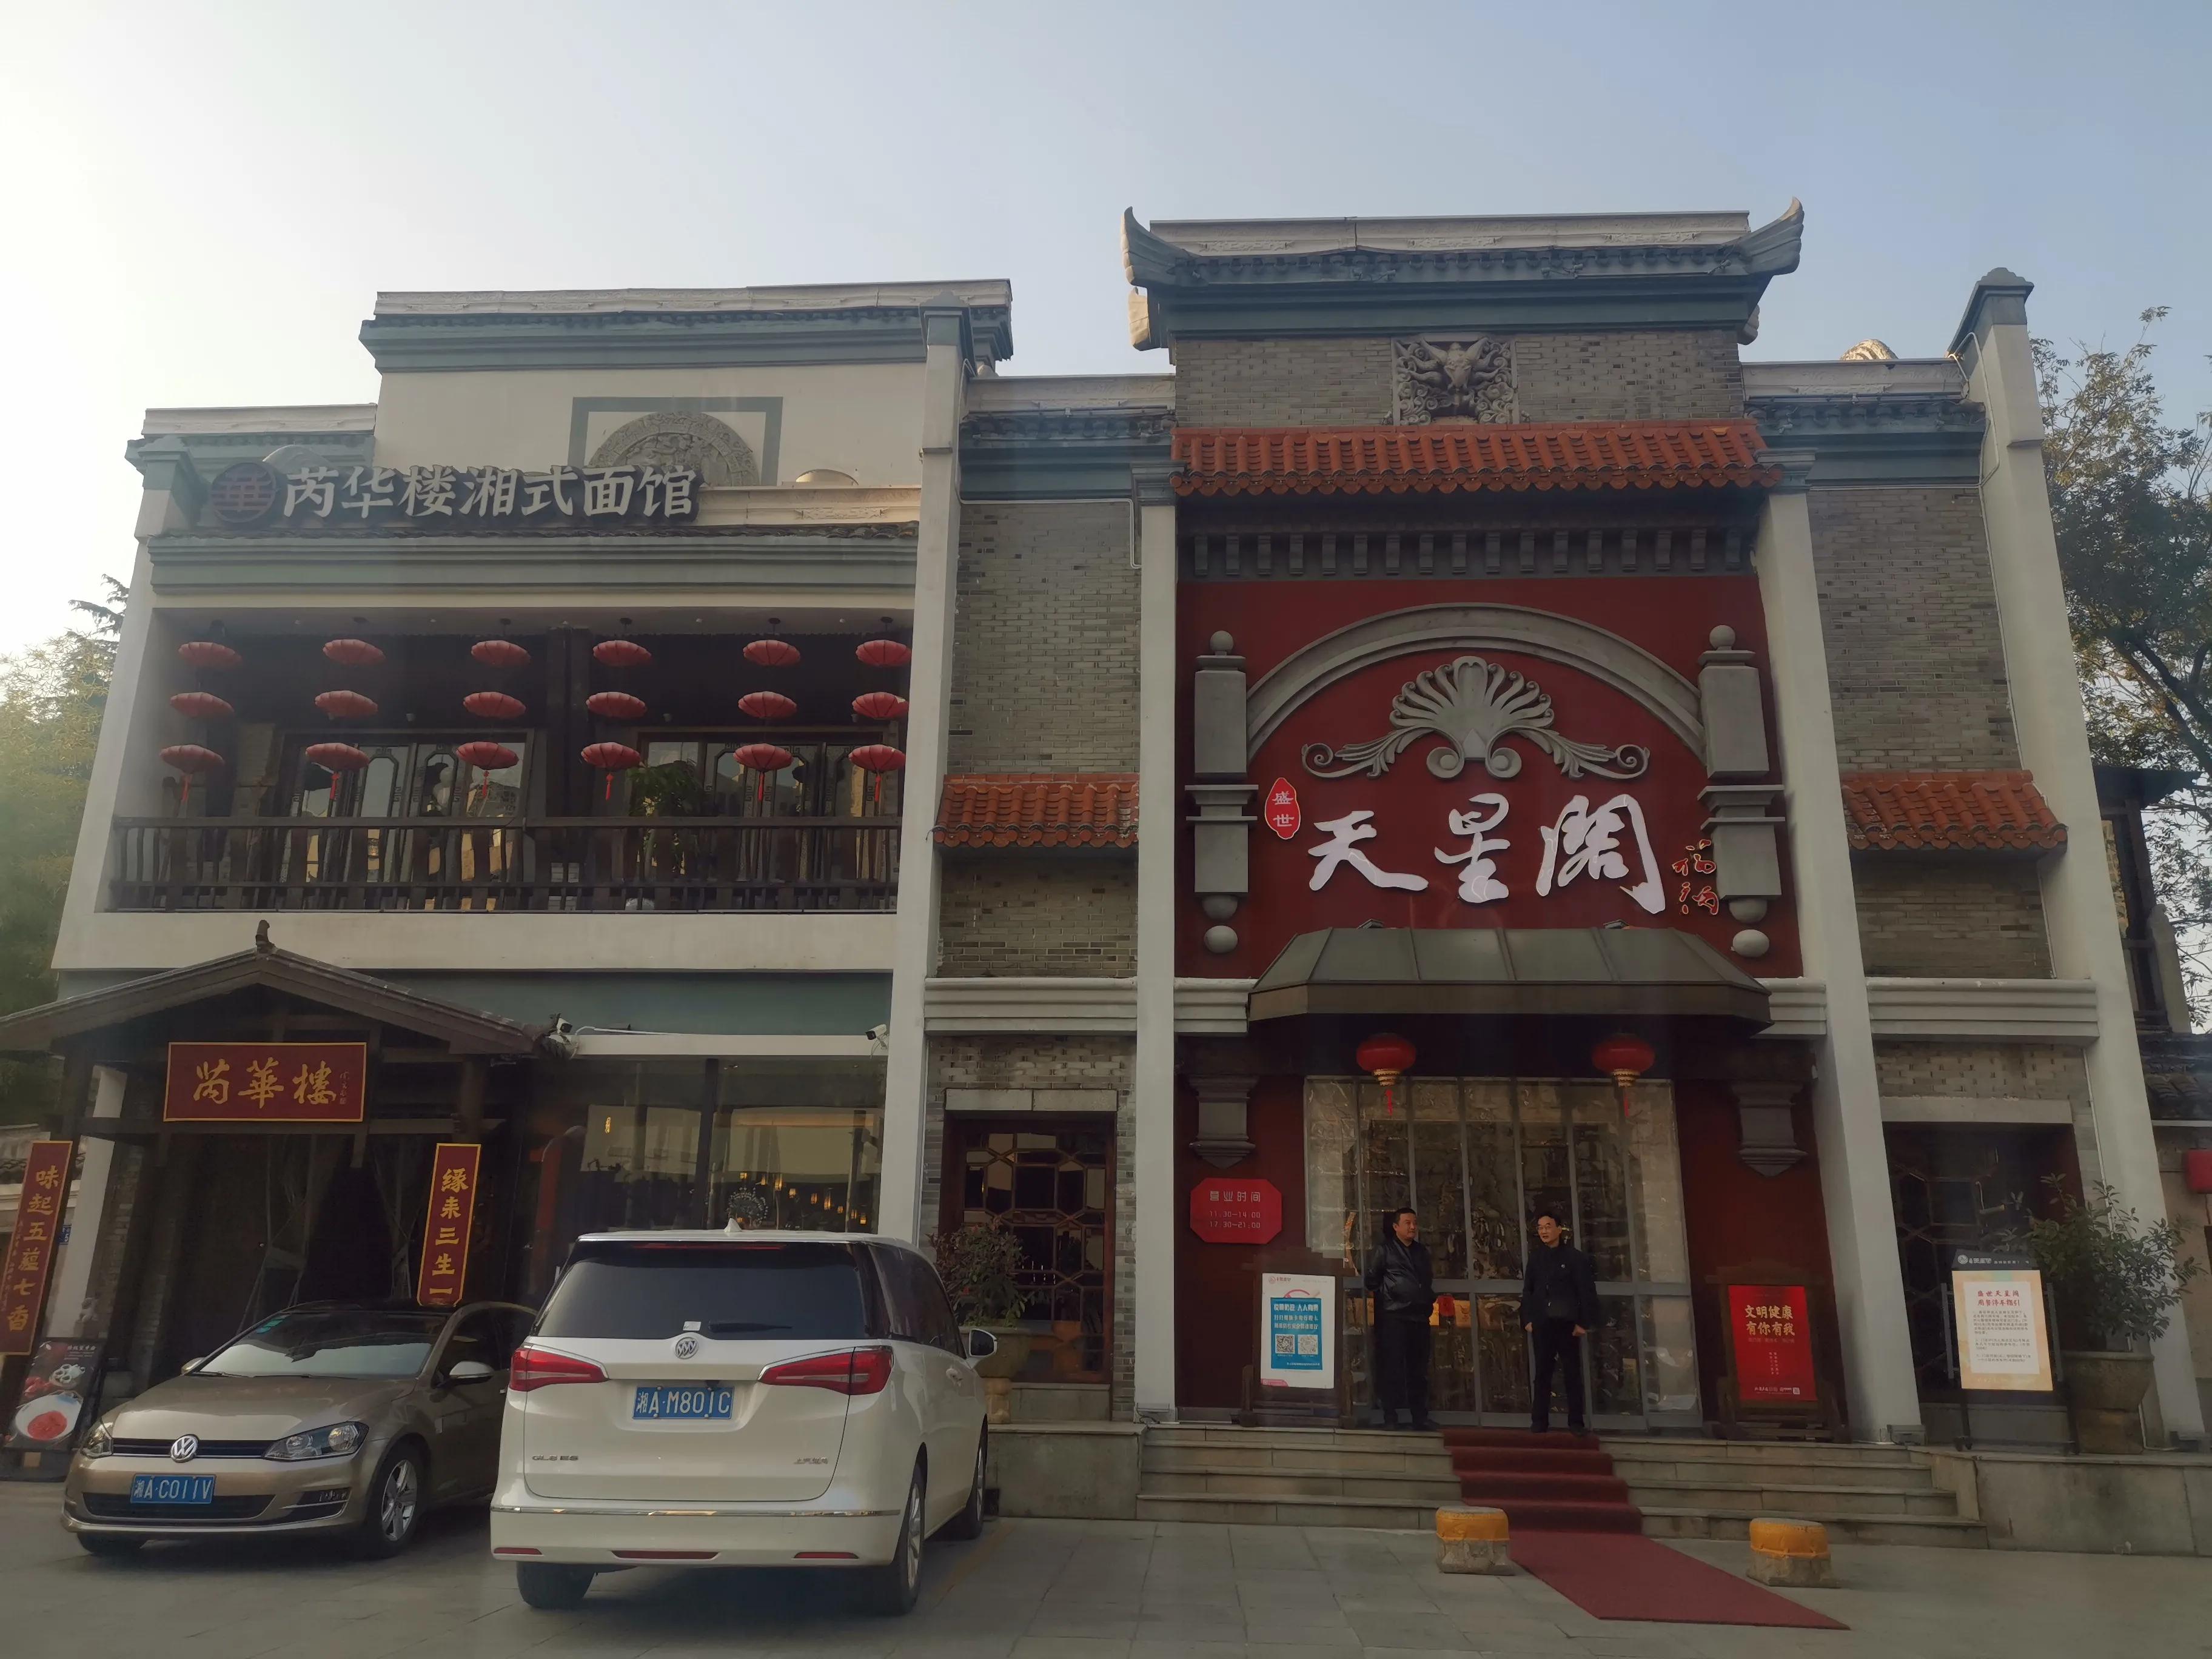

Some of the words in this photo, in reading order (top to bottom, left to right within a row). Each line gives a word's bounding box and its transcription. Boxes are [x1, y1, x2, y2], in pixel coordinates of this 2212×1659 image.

[284, 464, 697, 518] 芮华楼湘式面馆
[1272, 791, 1295, 827] 盛世
[1210, 1191, 1261, 1202] 营业时间
[429, 1167, 469, 1305] 缘来三生一
[1744, 1305, 1793, 1319] 文明健康
[1746, 1321, 1795, 1336] 有你有我
